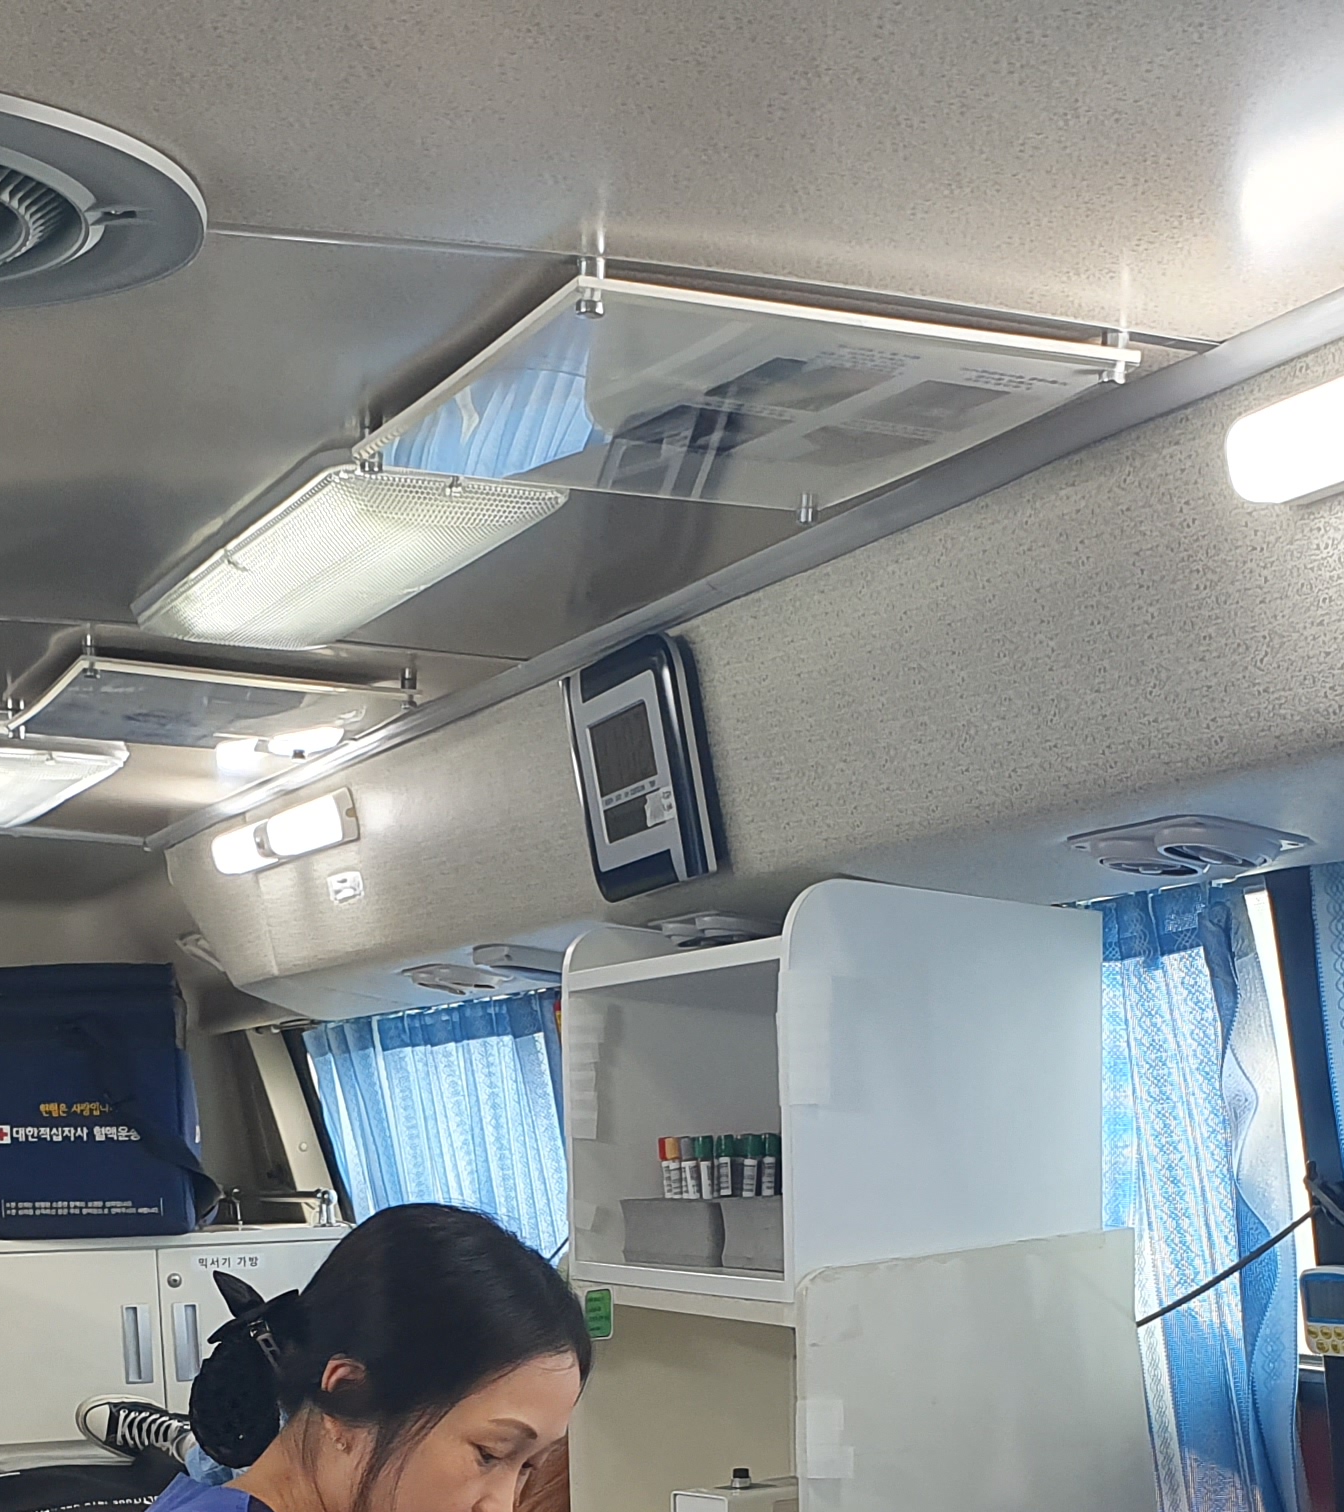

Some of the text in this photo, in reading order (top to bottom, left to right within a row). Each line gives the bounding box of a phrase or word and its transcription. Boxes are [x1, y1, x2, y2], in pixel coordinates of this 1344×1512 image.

[71, 1102, 114, 1116] 사랑입니
[12, 1126, 89, 1142] 대한적십자사
[198, 1255, 260, 1269] 믹서기 가방
